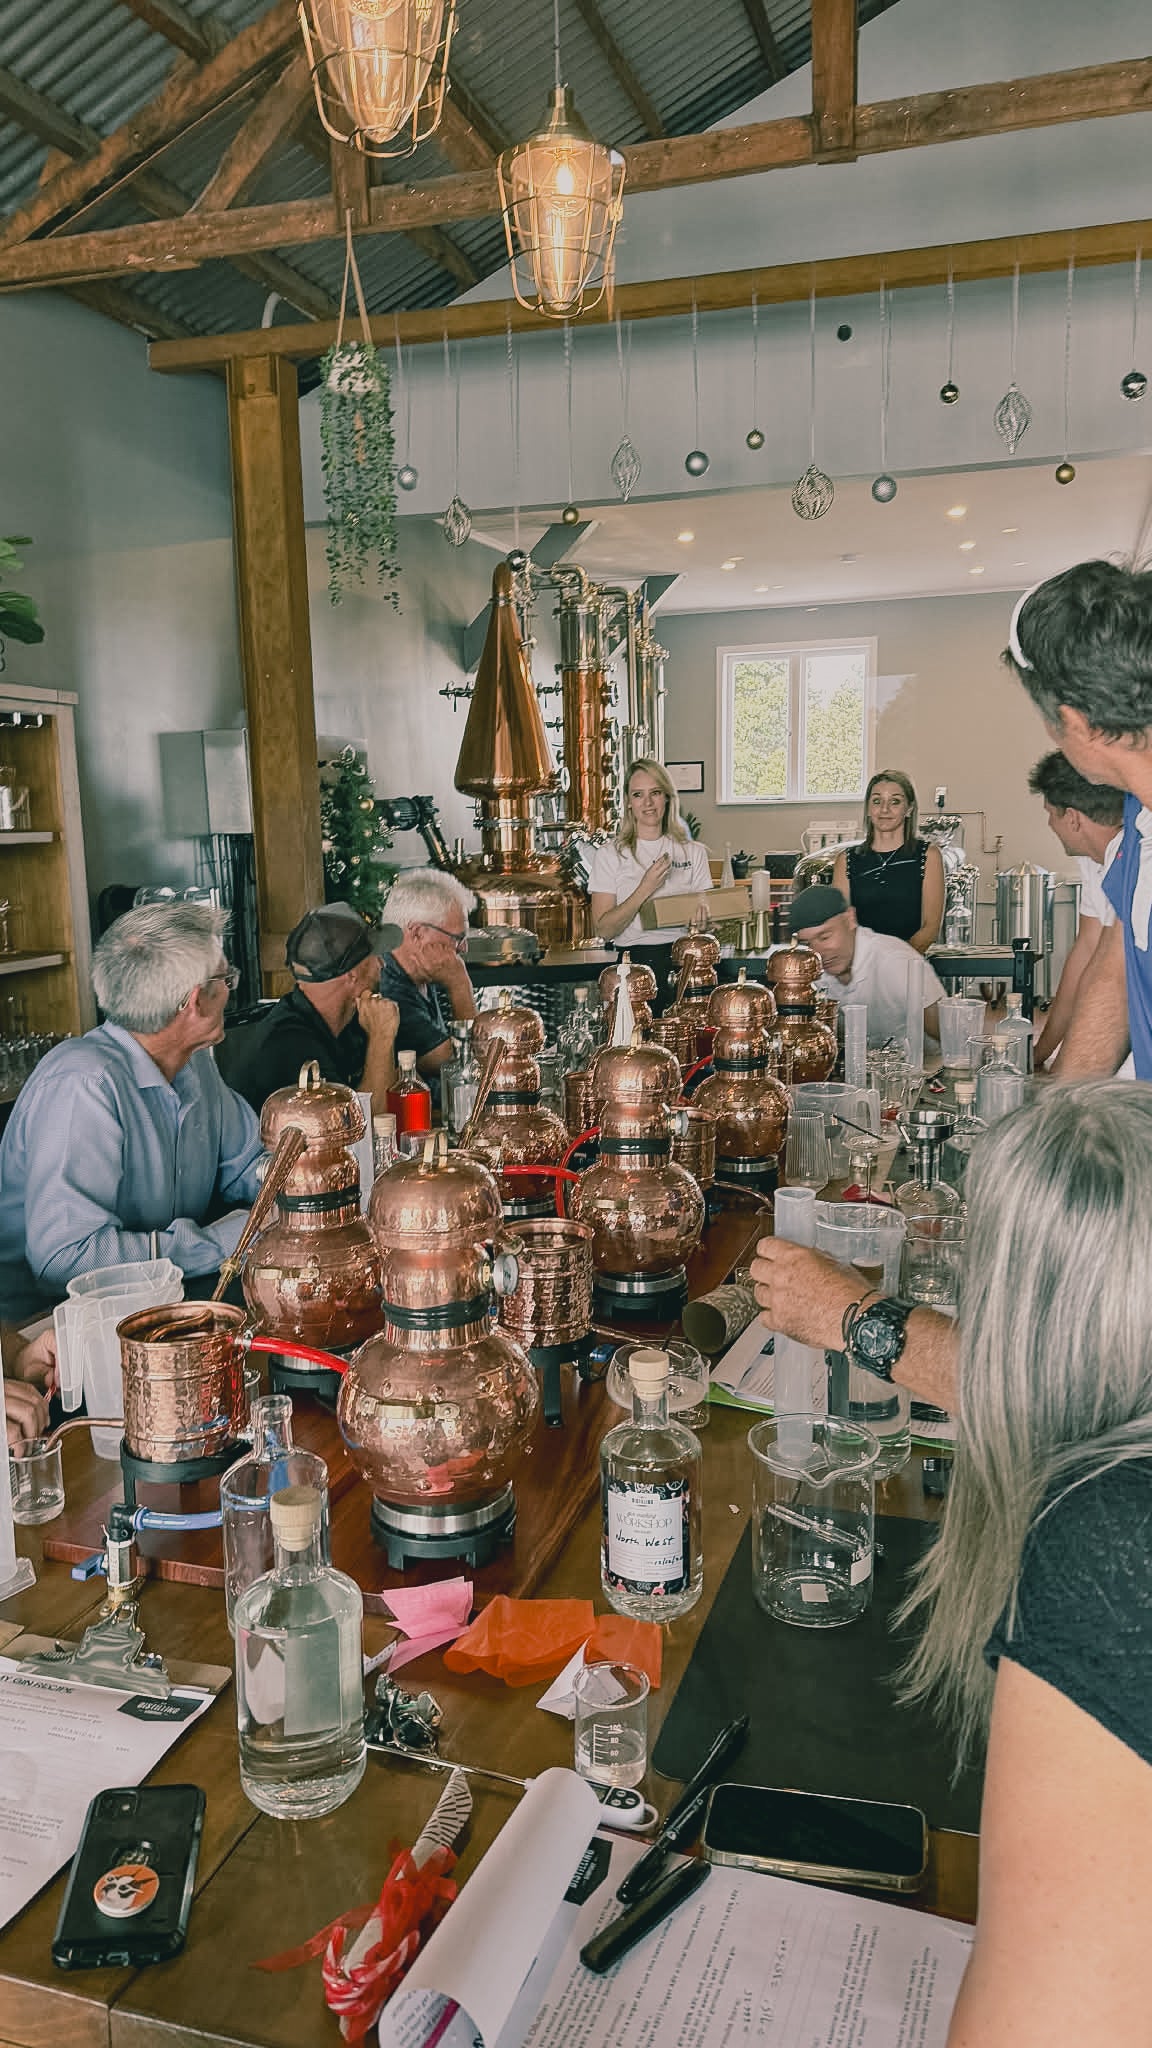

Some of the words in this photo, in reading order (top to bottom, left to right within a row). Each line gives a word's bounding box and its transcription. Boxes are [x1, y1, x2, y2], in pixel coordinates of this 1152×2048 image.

[616, 1513, 673, 1529] WORKSHOP
[615, 1530, 640, 1545] North
[645, 1537, 674, 1547] West
